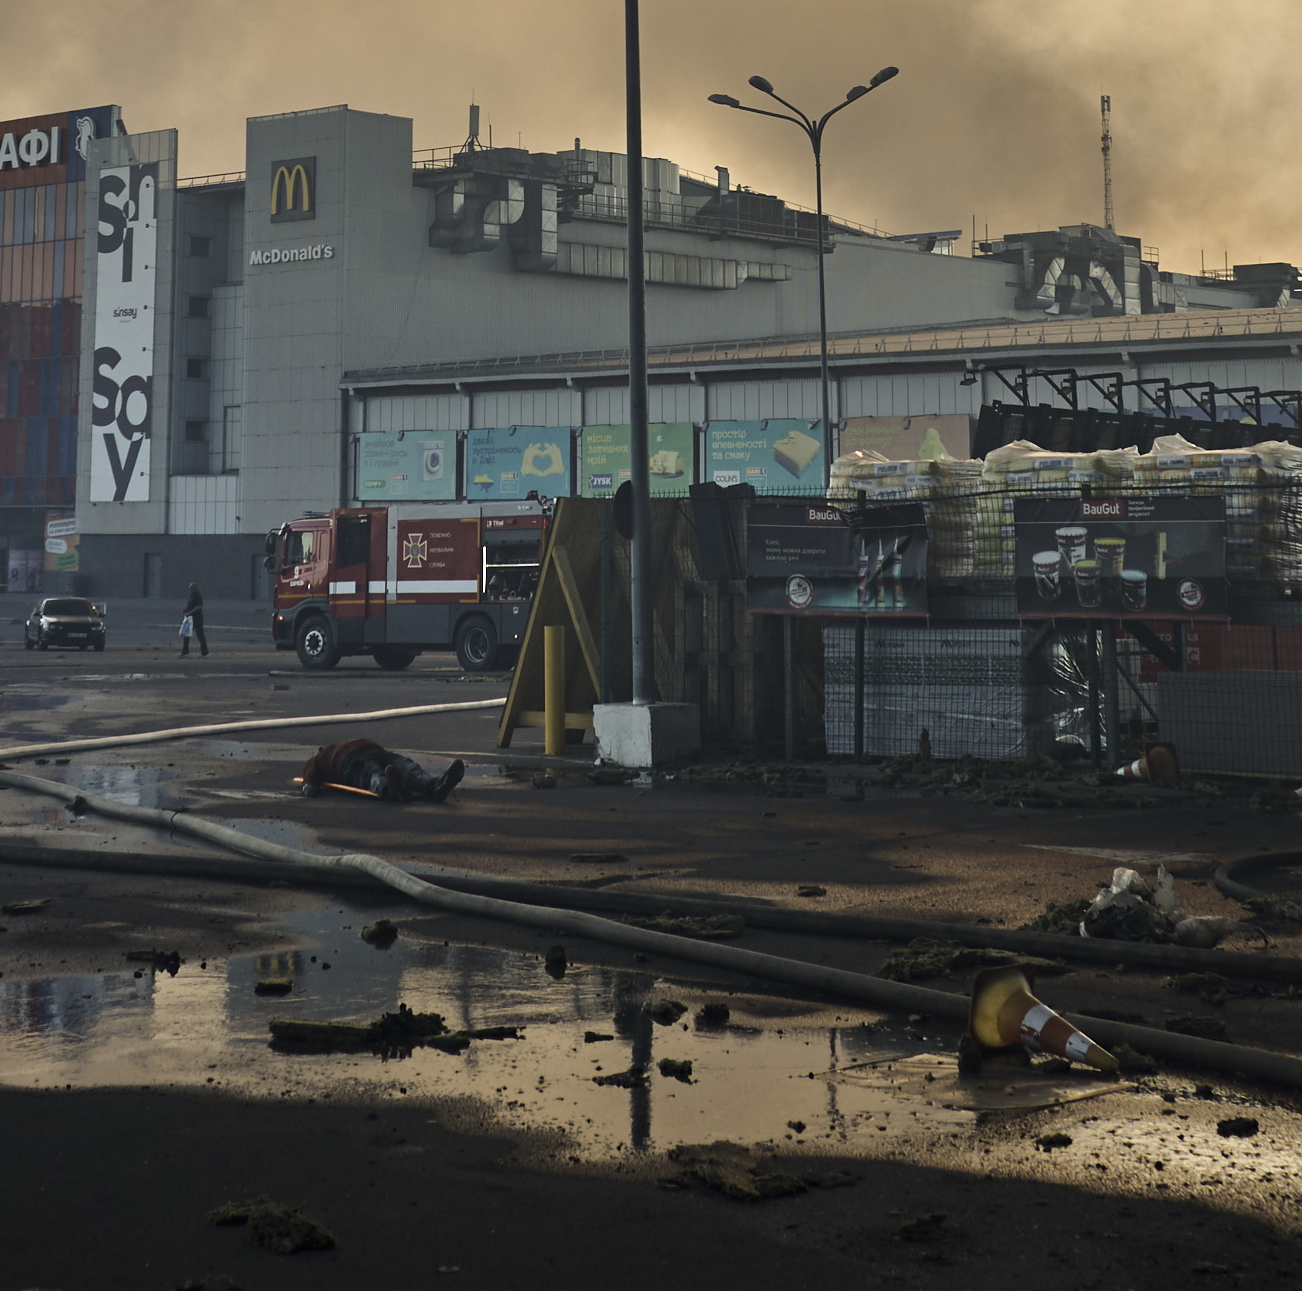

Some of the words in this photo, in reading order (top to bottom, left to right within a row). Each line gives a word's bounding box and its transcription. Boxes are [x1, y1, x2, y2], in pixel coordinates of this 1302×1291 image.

[250, 244, 334, 265] McDonald's
[712, 428, 747, 440] простір
[712, 438, 768, 449] впевненості
[712, 452, 723, 460] та
[725, 452, 751, 461] смаку
[593, 477, 612, 486] JYSK
[1083, 503, 1120, 515] BauGut
